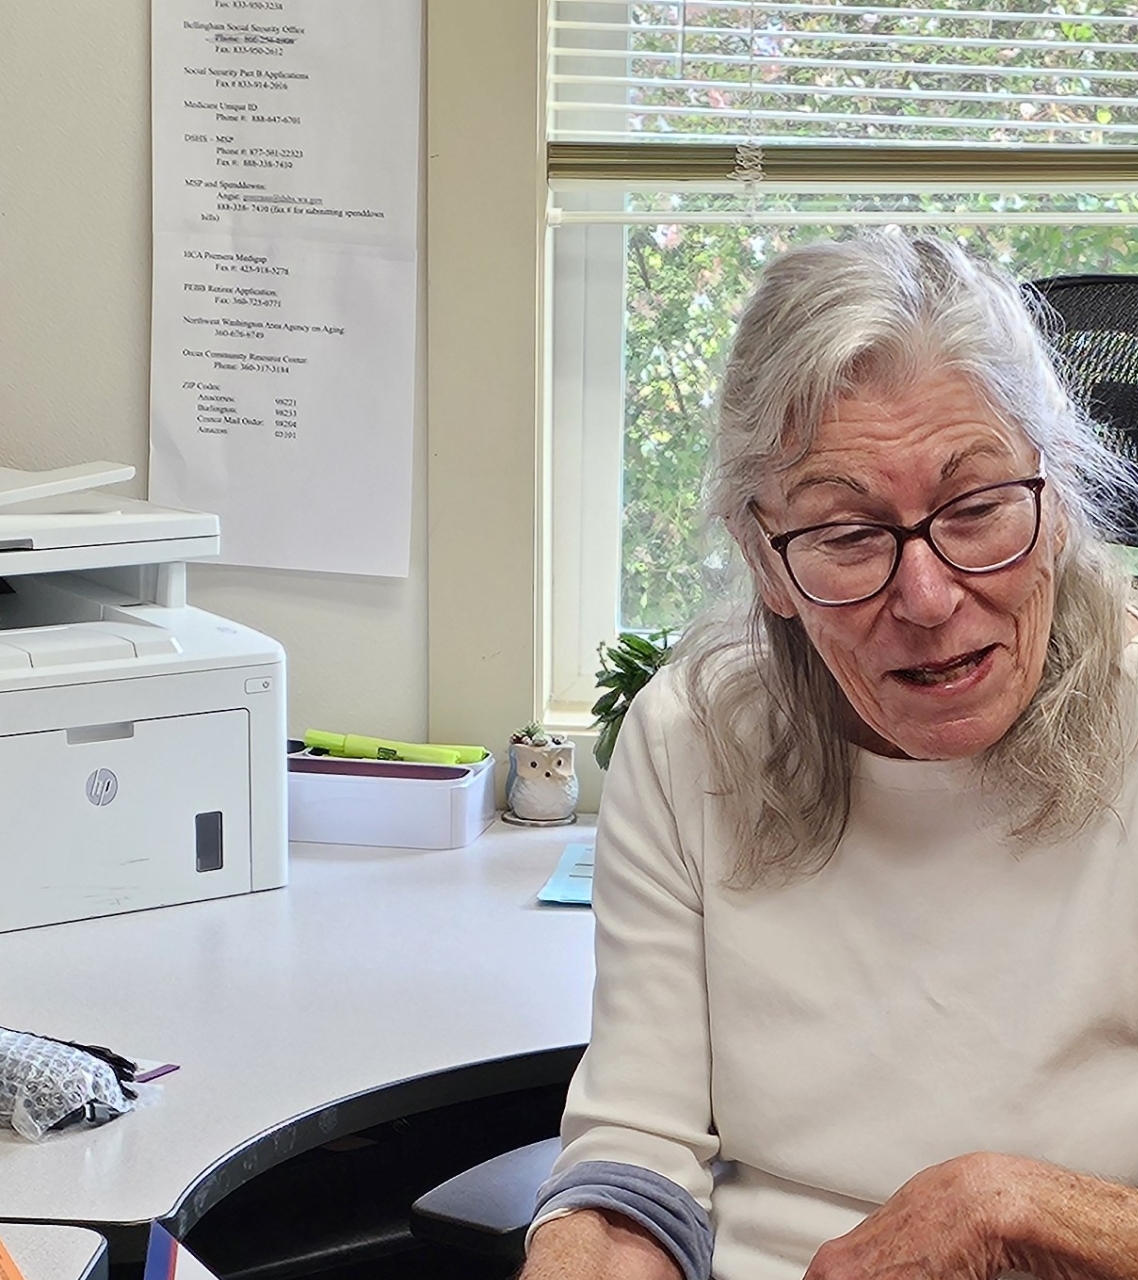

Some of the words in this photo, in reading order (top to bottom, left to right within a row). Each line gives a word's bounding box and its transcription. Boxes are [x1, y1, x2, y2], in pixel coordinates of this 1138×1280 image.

[183, 21, 225, 31] Bellingham
[227, 23, 249, 31] Social
[251, 24, 280, 34] Security
[282, 25, 305, 34] Office
[183, 67, 206, 75] Social
[209, 68, 237, 77] Security
[264, 70, 309, 80] Applications
[215, 79, 229, 87] Fax
[184, 100, 218, 109] Medicare
[219, 102, 246, 112] Unique
[216, 113, 238, 121] Phone
[216, 147, 238, 155] Phone
[204, 180, 217, 188] and
[305, 207, 343, 218] submitting
[345, 210, 385, 219] spenddown
[235, 253, 267, 264] Medigap
[182, 316, 220, 325] Northwest
[221, 318, 264, 329] Washington
[265, 321, 281, 329] Area
[283, 323, 309, 333] Agency
[323, 325, 345, 335] Aging
[205, 350, 247, 361] Community
[249, 353, 281, 362] Resource
[223, 415, 240, 424] Mail
